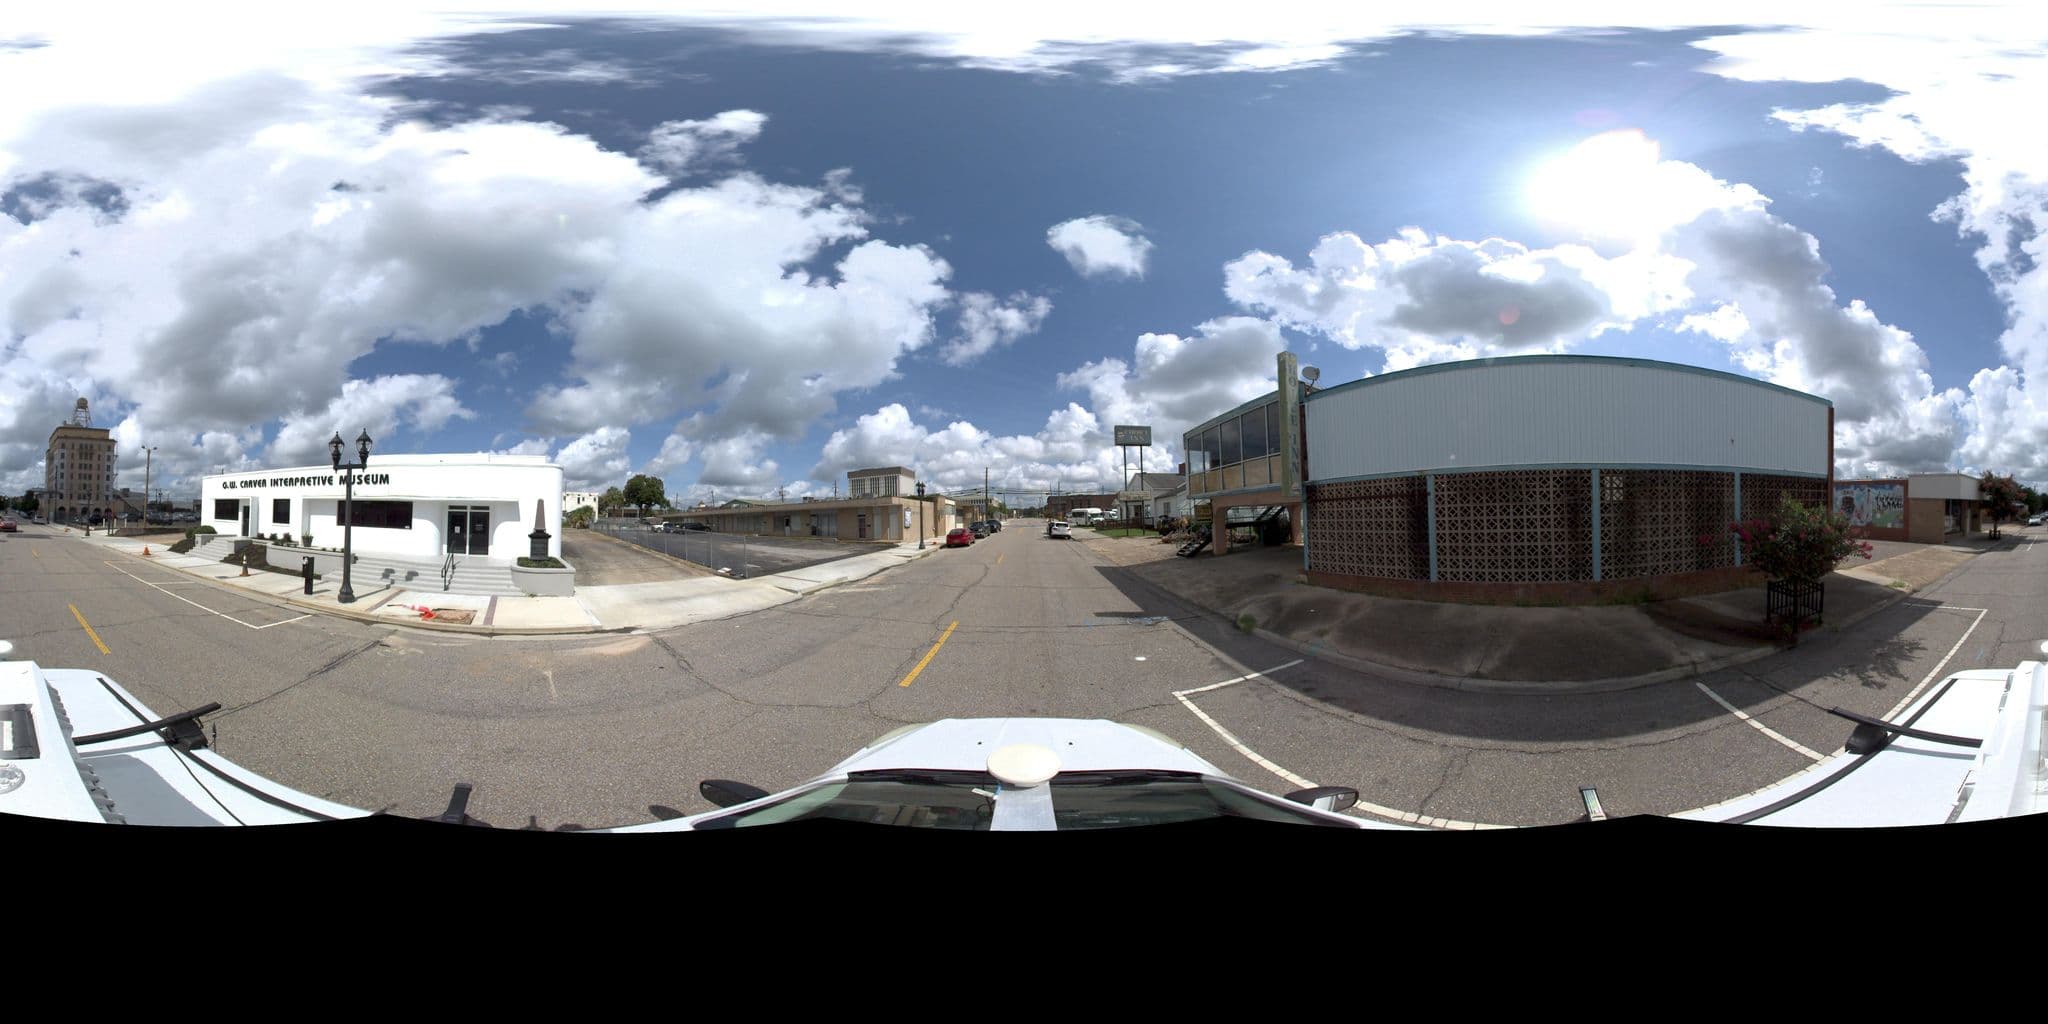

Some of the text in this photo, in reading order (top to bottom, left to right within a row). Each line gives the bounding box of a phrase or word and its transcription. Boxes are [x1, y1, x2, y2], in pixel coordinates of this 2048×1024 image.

[240, 478, 267, 488] CARVER
[270, 475, 334, 487] INTERPRETIVE
[339, 473, 390, 485] MUSEUM
